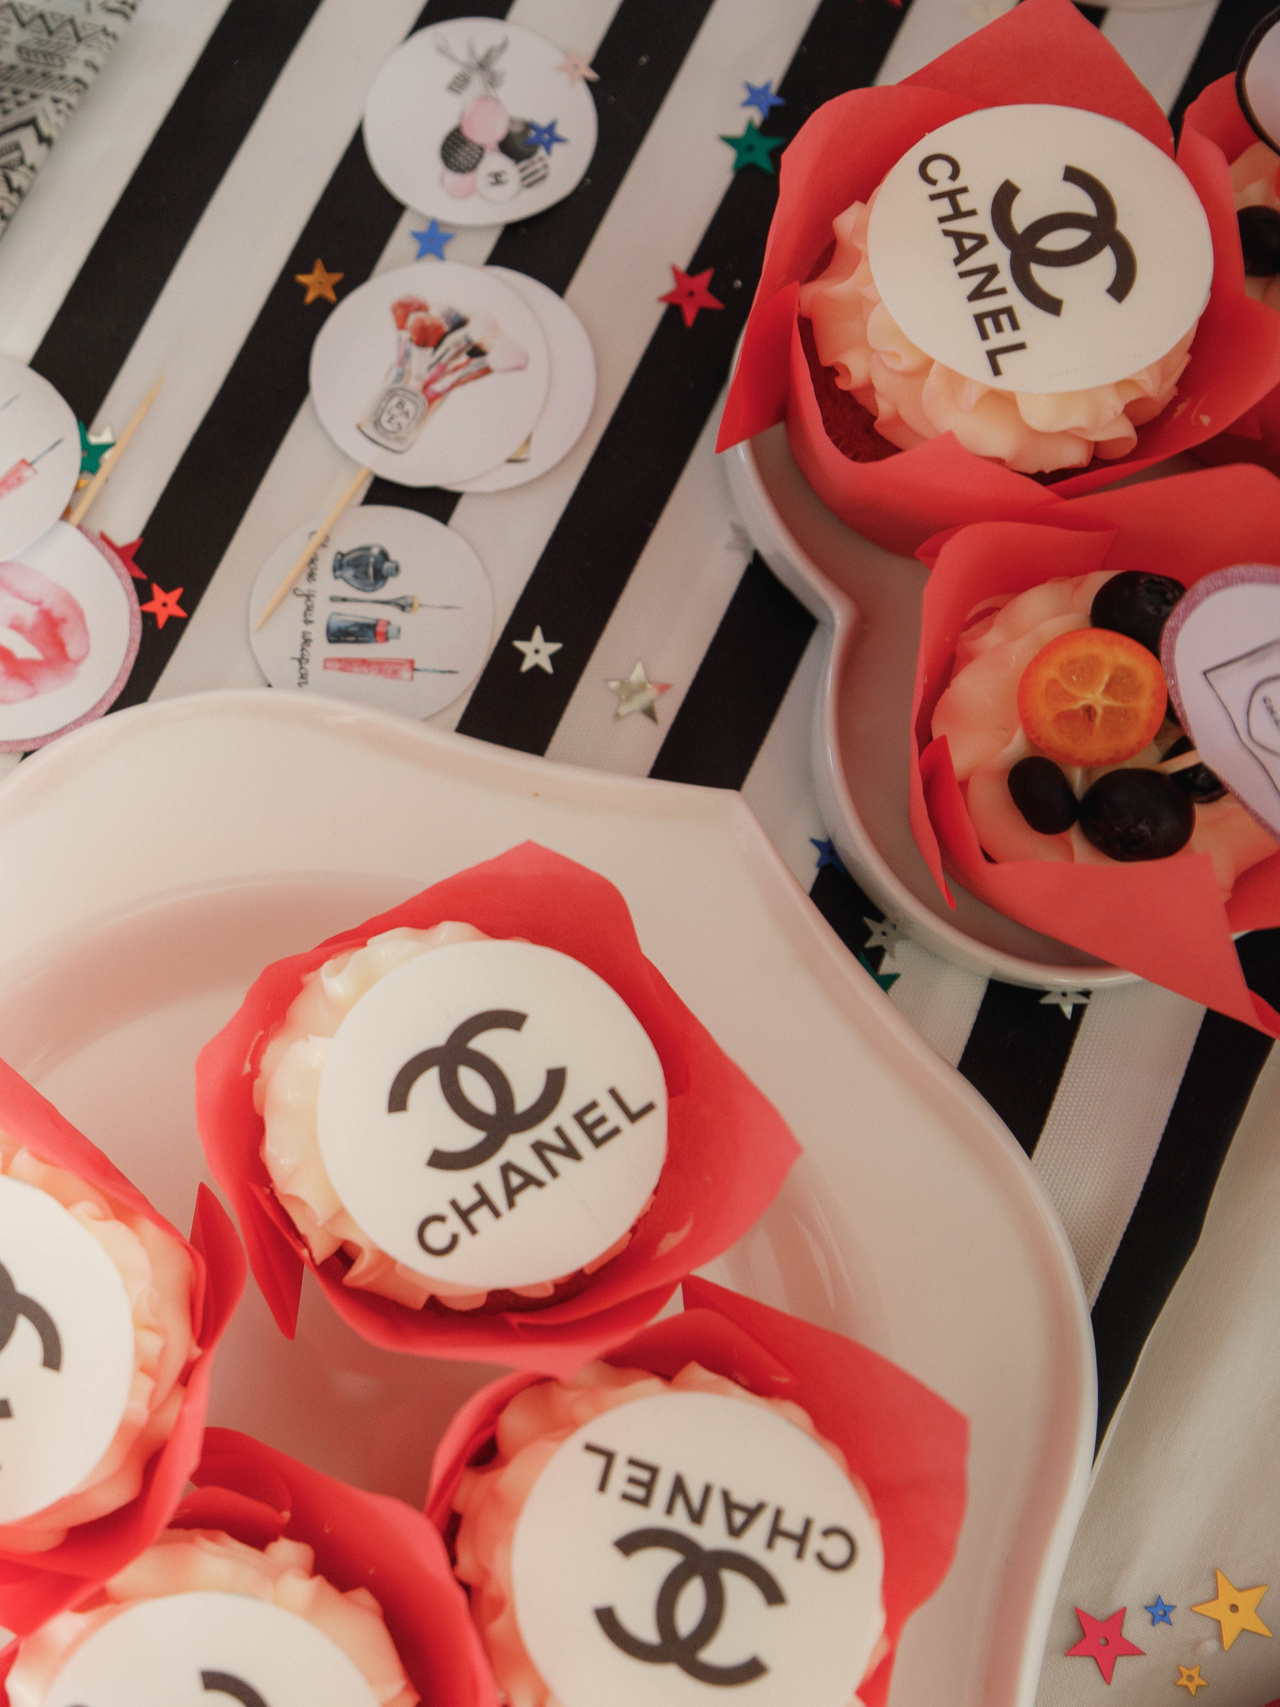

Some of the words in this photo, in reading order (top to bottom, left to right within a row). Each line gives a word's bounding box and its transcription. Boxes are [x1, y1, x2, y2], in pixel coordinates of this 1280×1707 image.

[918, 153, 1028, 377] CHANEL
[289, 630, 314, 688] weapon
[292, 587, 317, 625] your
[417, 1086, 657, 1257] CHANEL
[584, 1441, 858, 1572] CHANEL
